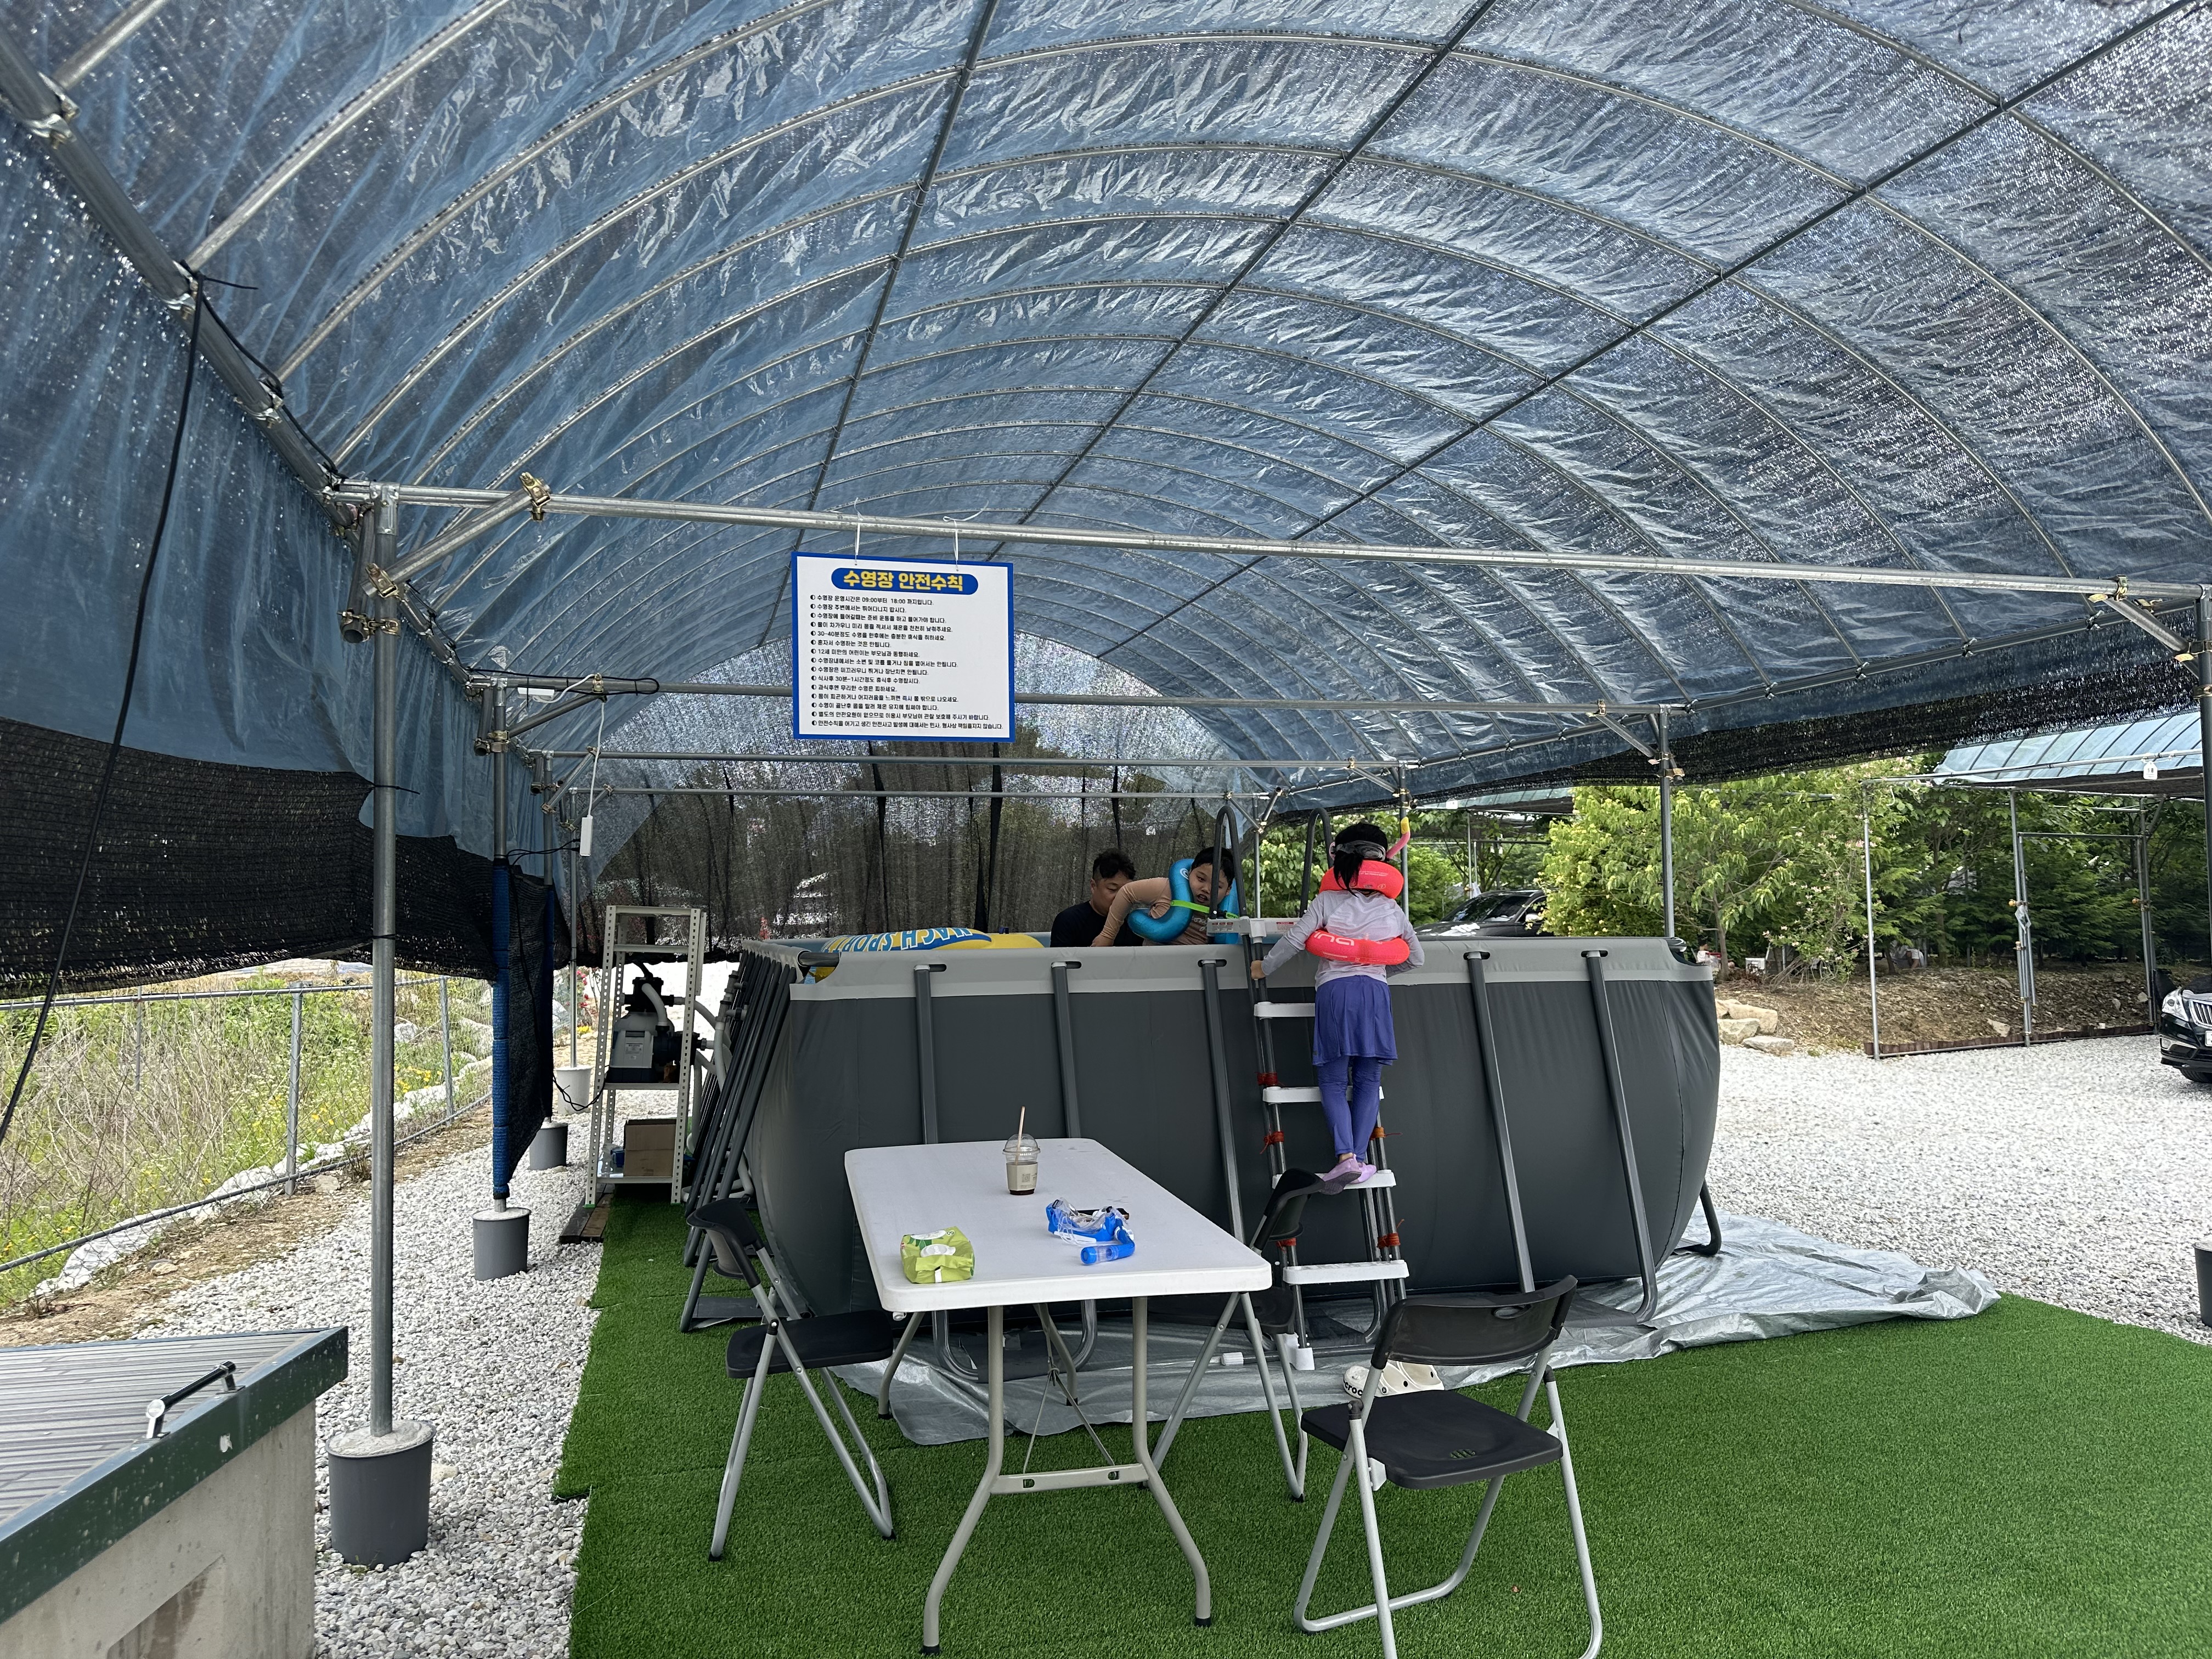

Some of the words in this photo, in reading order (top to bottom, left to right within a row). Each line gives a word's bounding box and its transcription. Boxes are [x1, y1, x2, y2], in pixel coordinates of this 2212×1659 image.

[844, 571, 894, 588] 수영장
[899, 573, 963, 591] 안전수칙
[1345, 1381, 1363, 1396] croc
